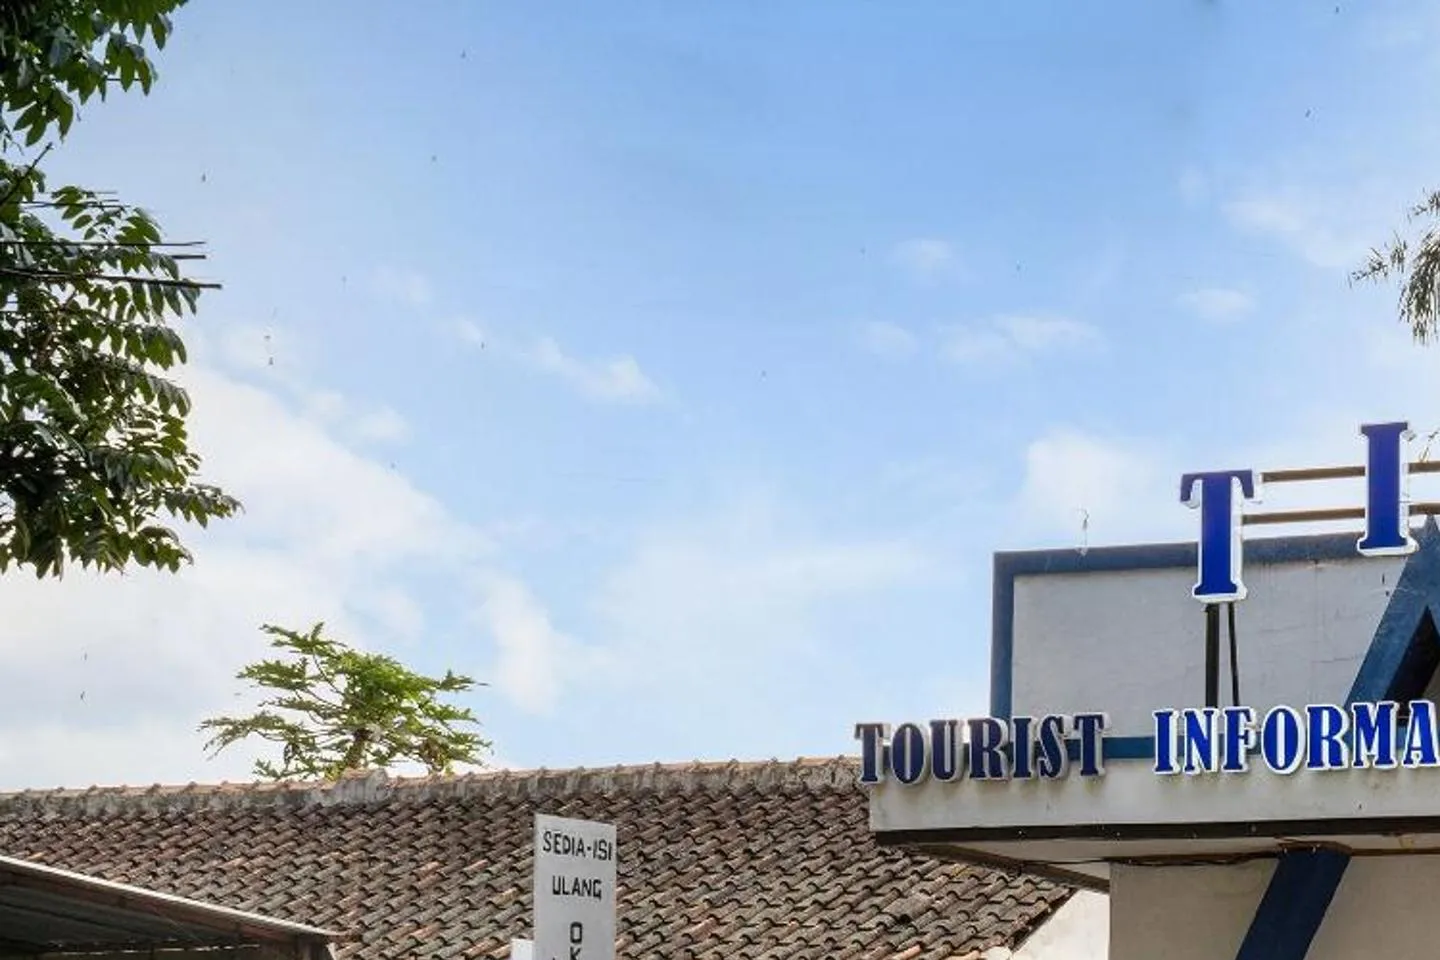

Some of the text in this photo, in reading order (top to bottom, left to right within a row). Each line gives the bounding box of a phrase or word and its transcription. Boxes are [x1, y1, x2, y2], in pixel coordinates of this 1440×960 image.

[855, 710, 1108, 785] TOURIST
[543, 831, 612, 861] SEDIA-ISI
[552, 876, 602, 900] ULANG
